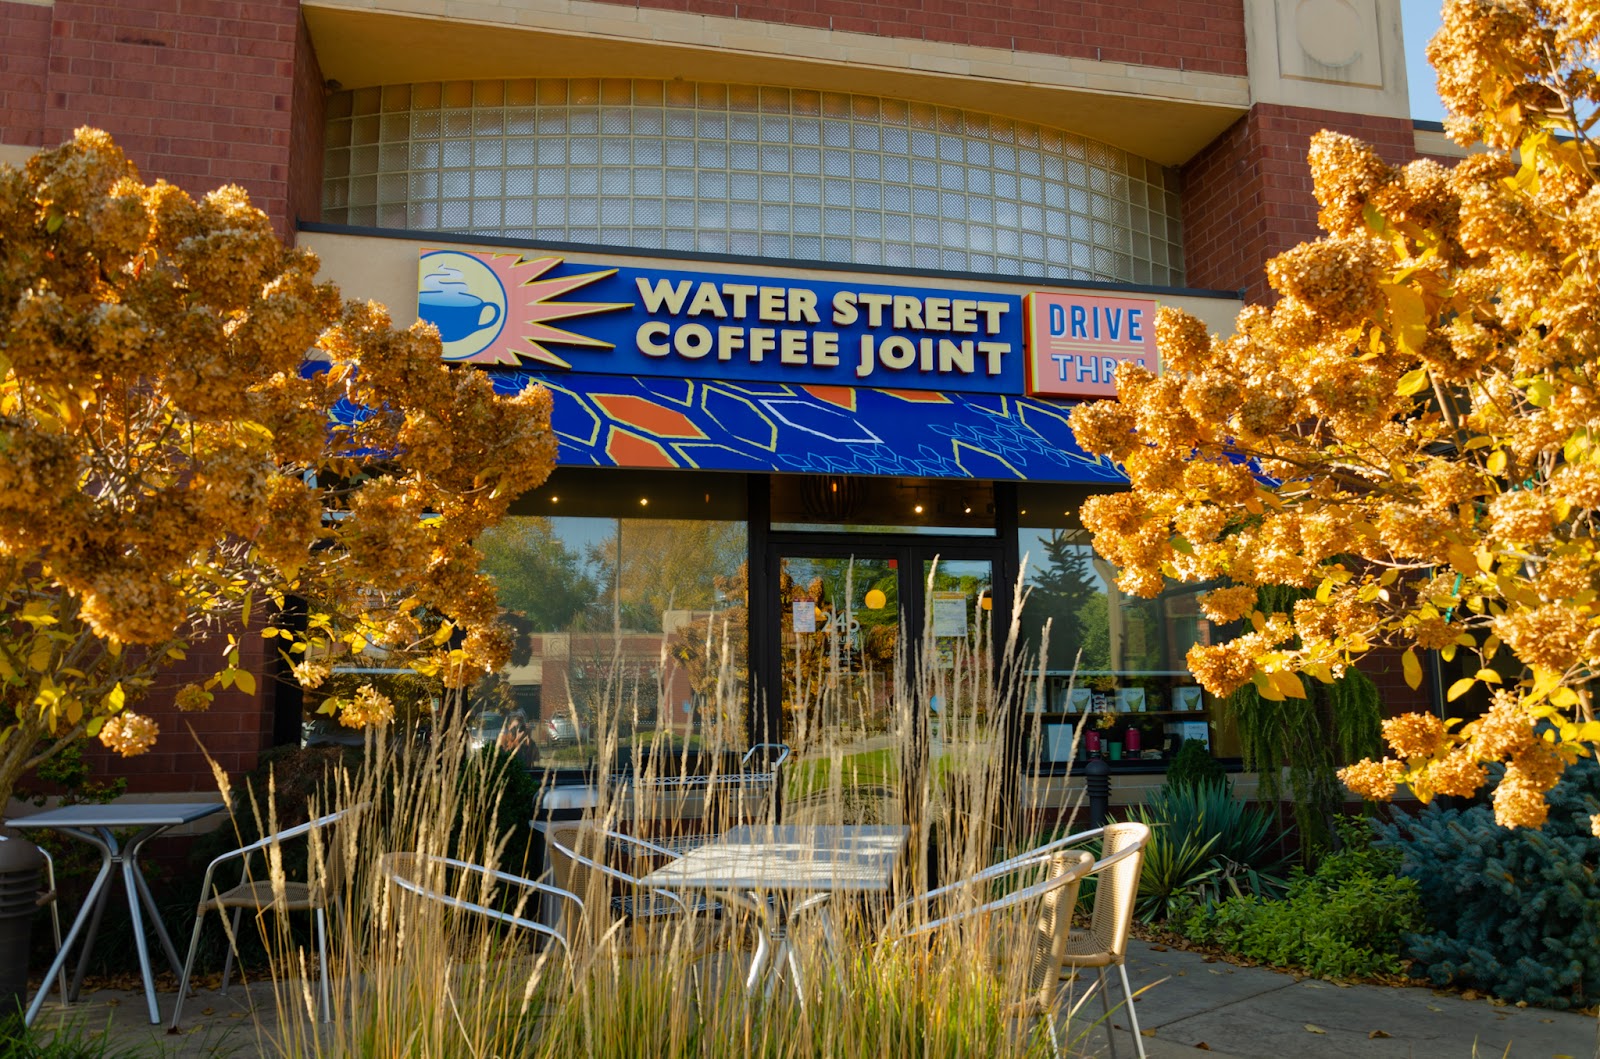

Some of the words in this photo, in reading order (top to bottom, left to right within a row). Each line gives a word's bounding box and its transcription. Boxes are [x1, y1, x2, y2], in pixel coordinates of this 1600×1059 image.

[635, 277, 822, 323] WATER
[832, 291, 1010, 335] STREET
[1049, 303, 1145, 343] DRIVE
[636, 321, 840, 367] COFFEE
[856, 334, 1012, 378] JOINT
[1051, 353, 1146, 384] THR
[820, 611, 860, 633] 245
